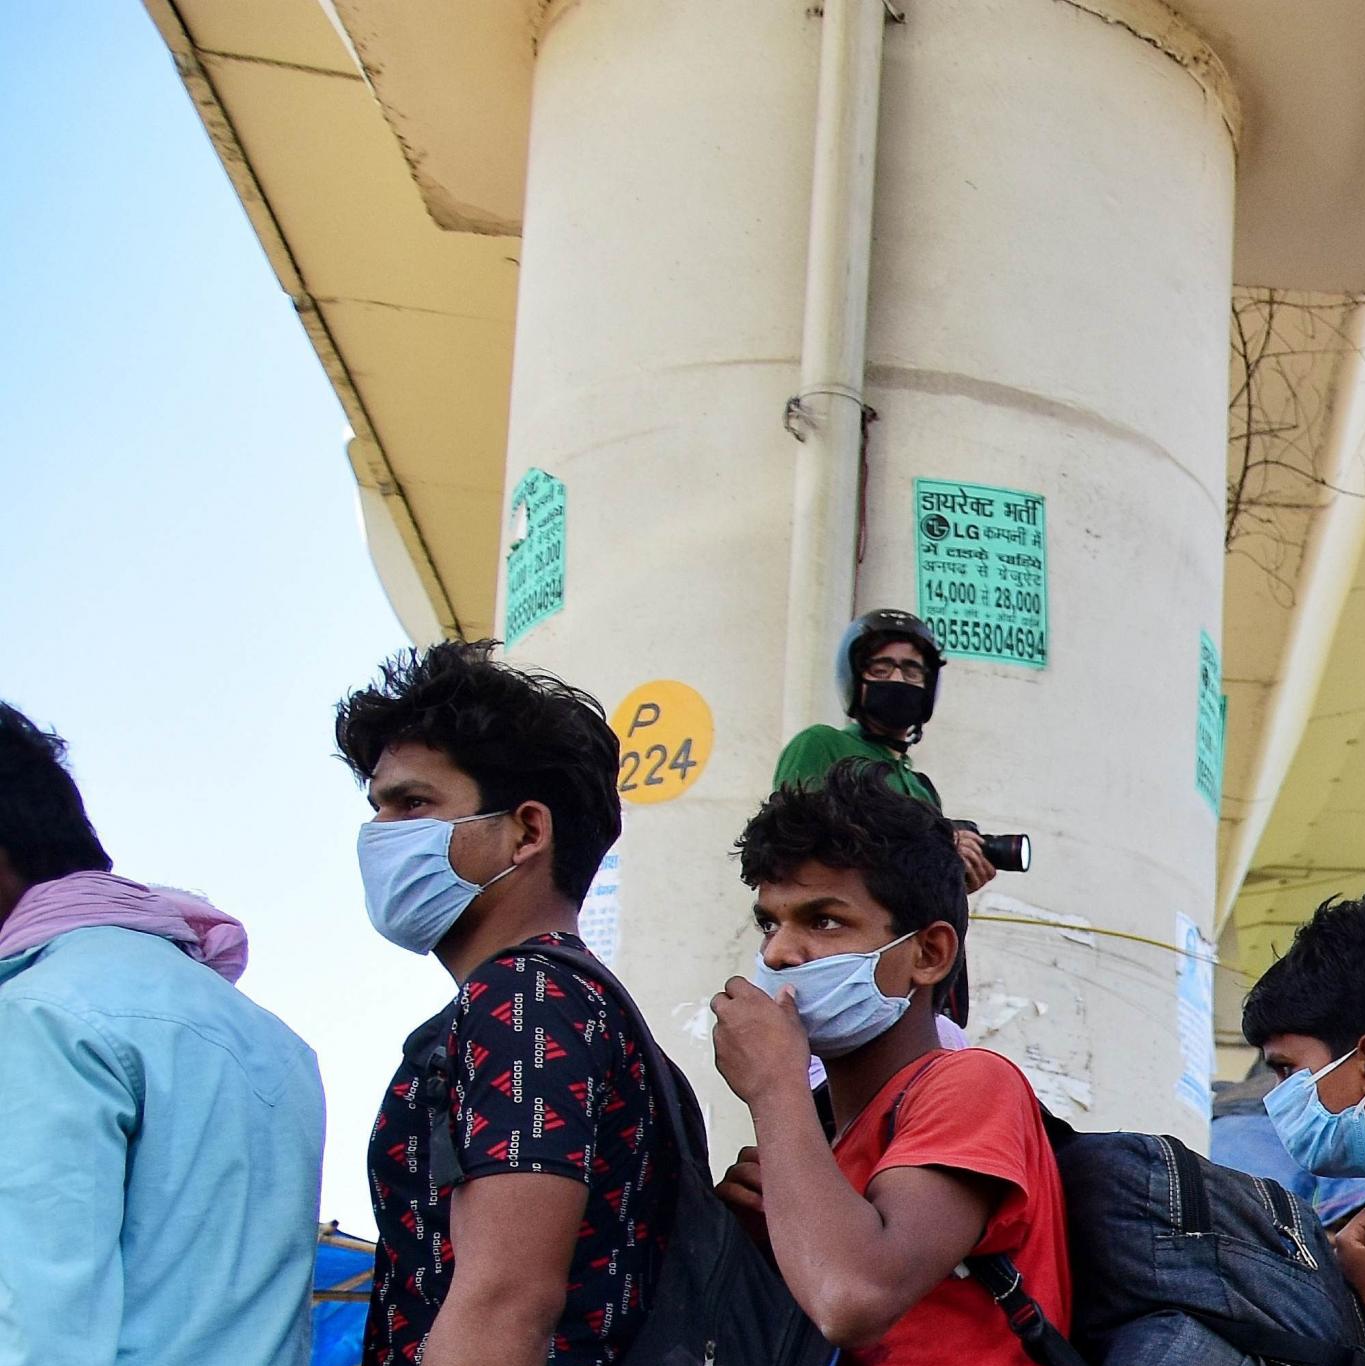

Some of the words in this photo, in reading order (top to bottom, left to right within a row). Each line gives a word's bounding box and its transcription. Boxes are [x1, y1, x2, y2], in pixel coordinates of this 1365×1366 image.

[919, 487, 994, 518] डायरेक्ट
[1003, 498, 1043, 526] भर्ती
[953, 522, 980, 540] LG
[926, 579, 976, 607] 14,000
[994, 586, 1041, 614] 28,000
[627, 702, 661, 738] P
[619, 737, 698, 792] 224
[512, 992, 524, 1032] adidaas
[534, 1026, 547, 1069] adidaas
[511, 1059, 523, 1104] adidaas
[533, 1097, 545, 1139] adidaas
